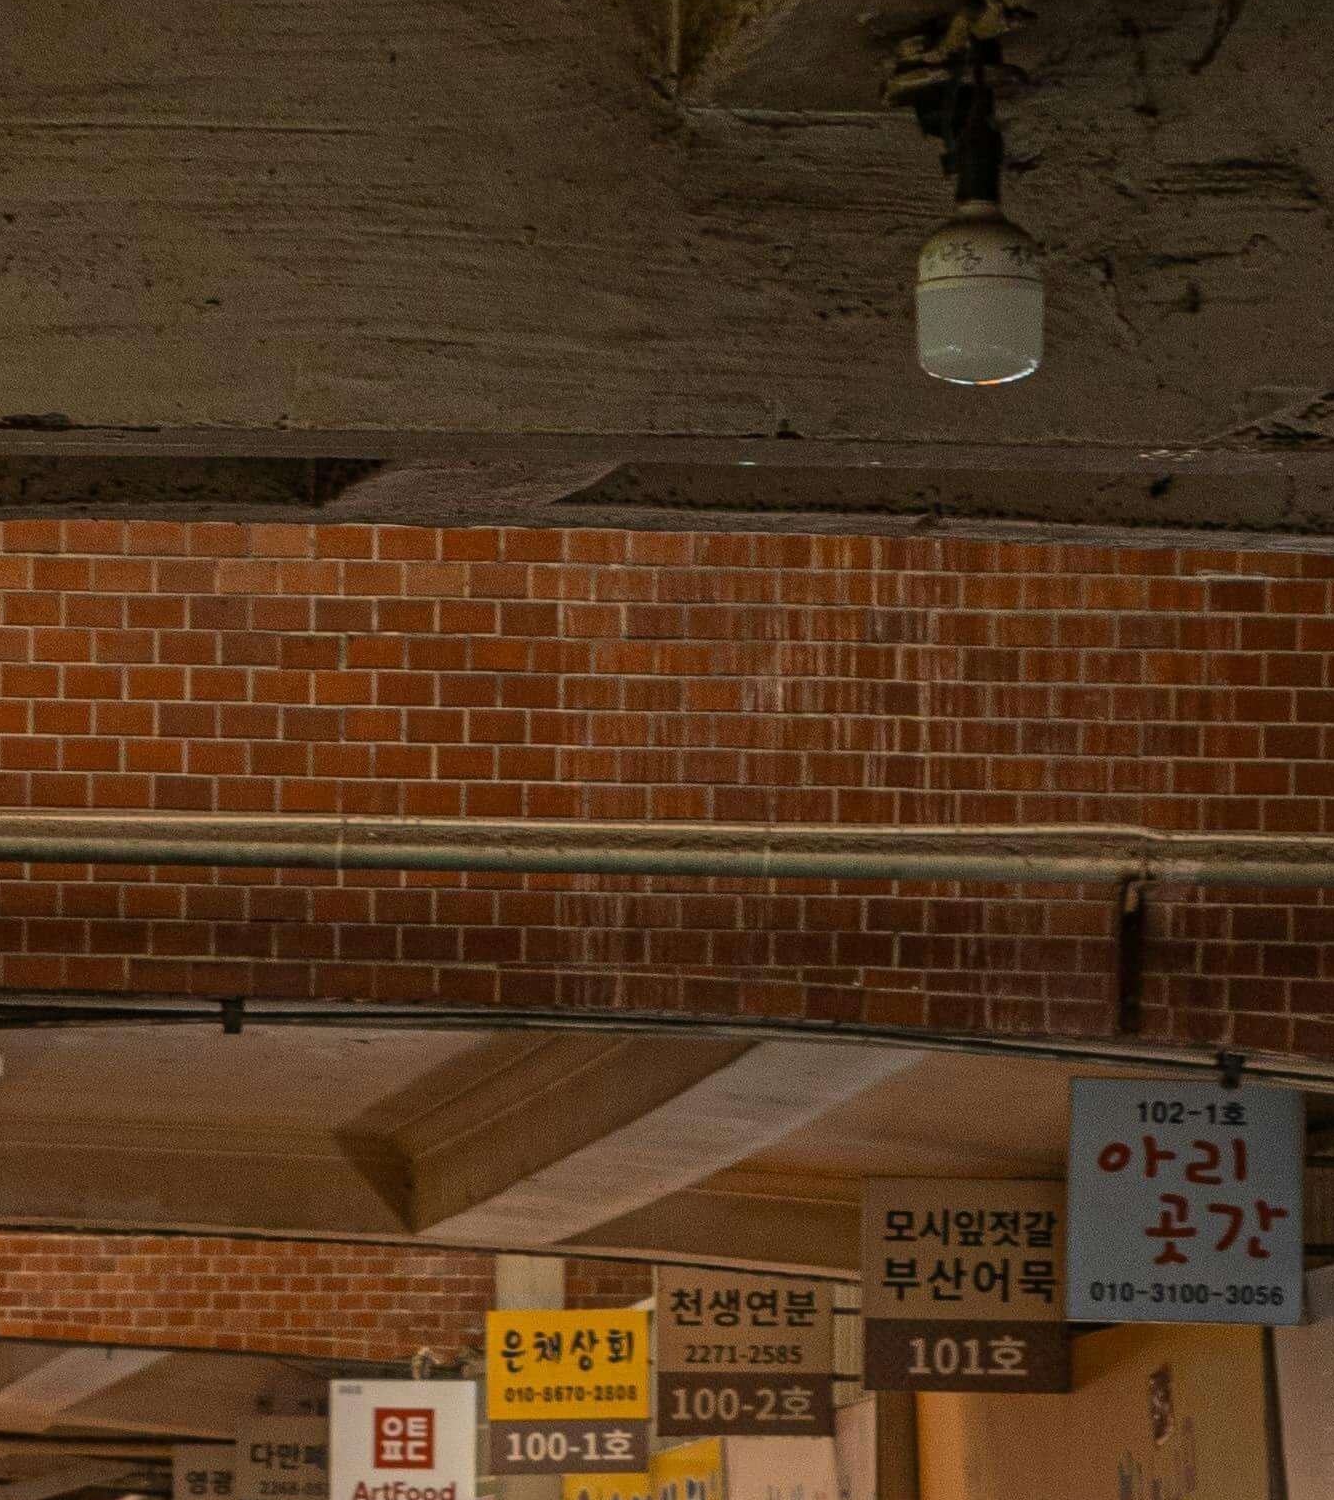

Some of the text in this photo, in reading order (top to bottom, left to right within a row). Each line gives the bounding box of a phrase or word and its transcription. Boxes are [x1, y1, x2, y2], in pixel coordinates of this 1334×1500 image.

[1136, 1101, 1249, 1127] 102-1호
[1097, 1137, 1249, 1186] 아리
[883, 1208, 1058, 1249] 모시잎젓갈
[880, 1257, 1058, 1303] 부산어묵
[1089, 1281, 1285, 1308] 010-3100-3056
[668, 1288, 819, 1327] 천생연분
[500, 1328, 635, 1373] 은채상회
[683, 1343, 804, 1367] 2271-2585
[907, 1338, 1029, 1377] 101호
[668, 1385, 817, 1423] 100-2호
[506, 1428, 635, 1462] 100-1호
